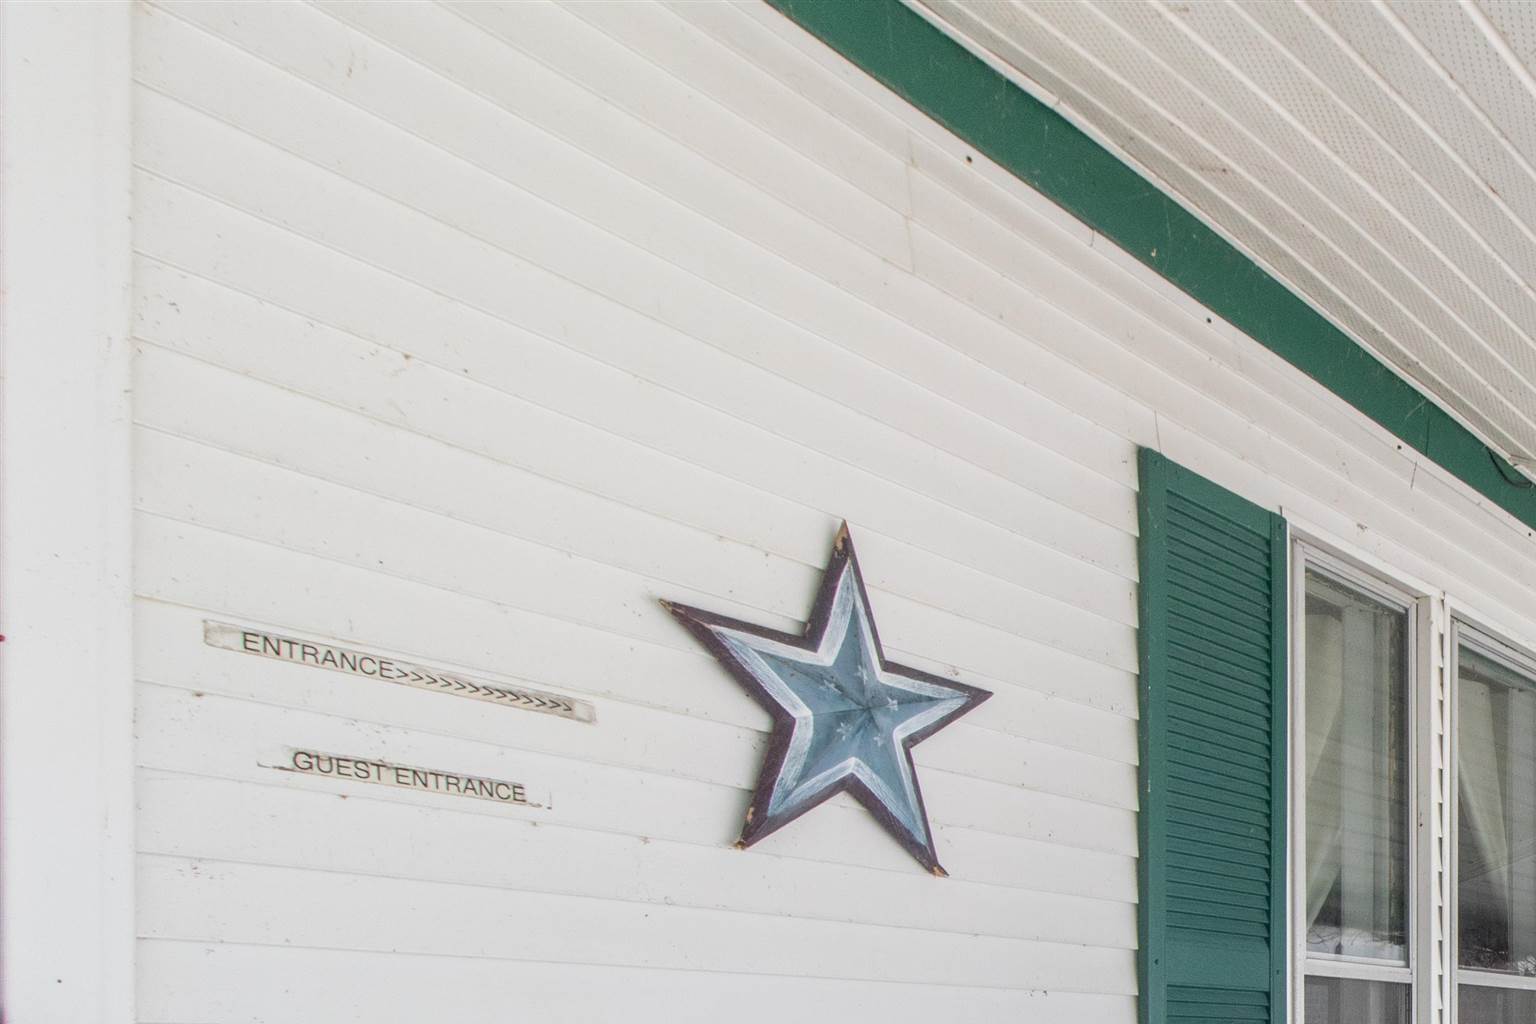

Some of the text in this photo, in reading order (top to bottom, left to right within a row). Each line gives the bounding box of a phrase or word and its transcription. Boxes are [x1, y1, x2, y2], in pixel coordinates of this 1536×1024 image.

[242, 631, 395, 680] ENTRANCE
[292, 751, 527, 803] GUEST ENTRANCE
